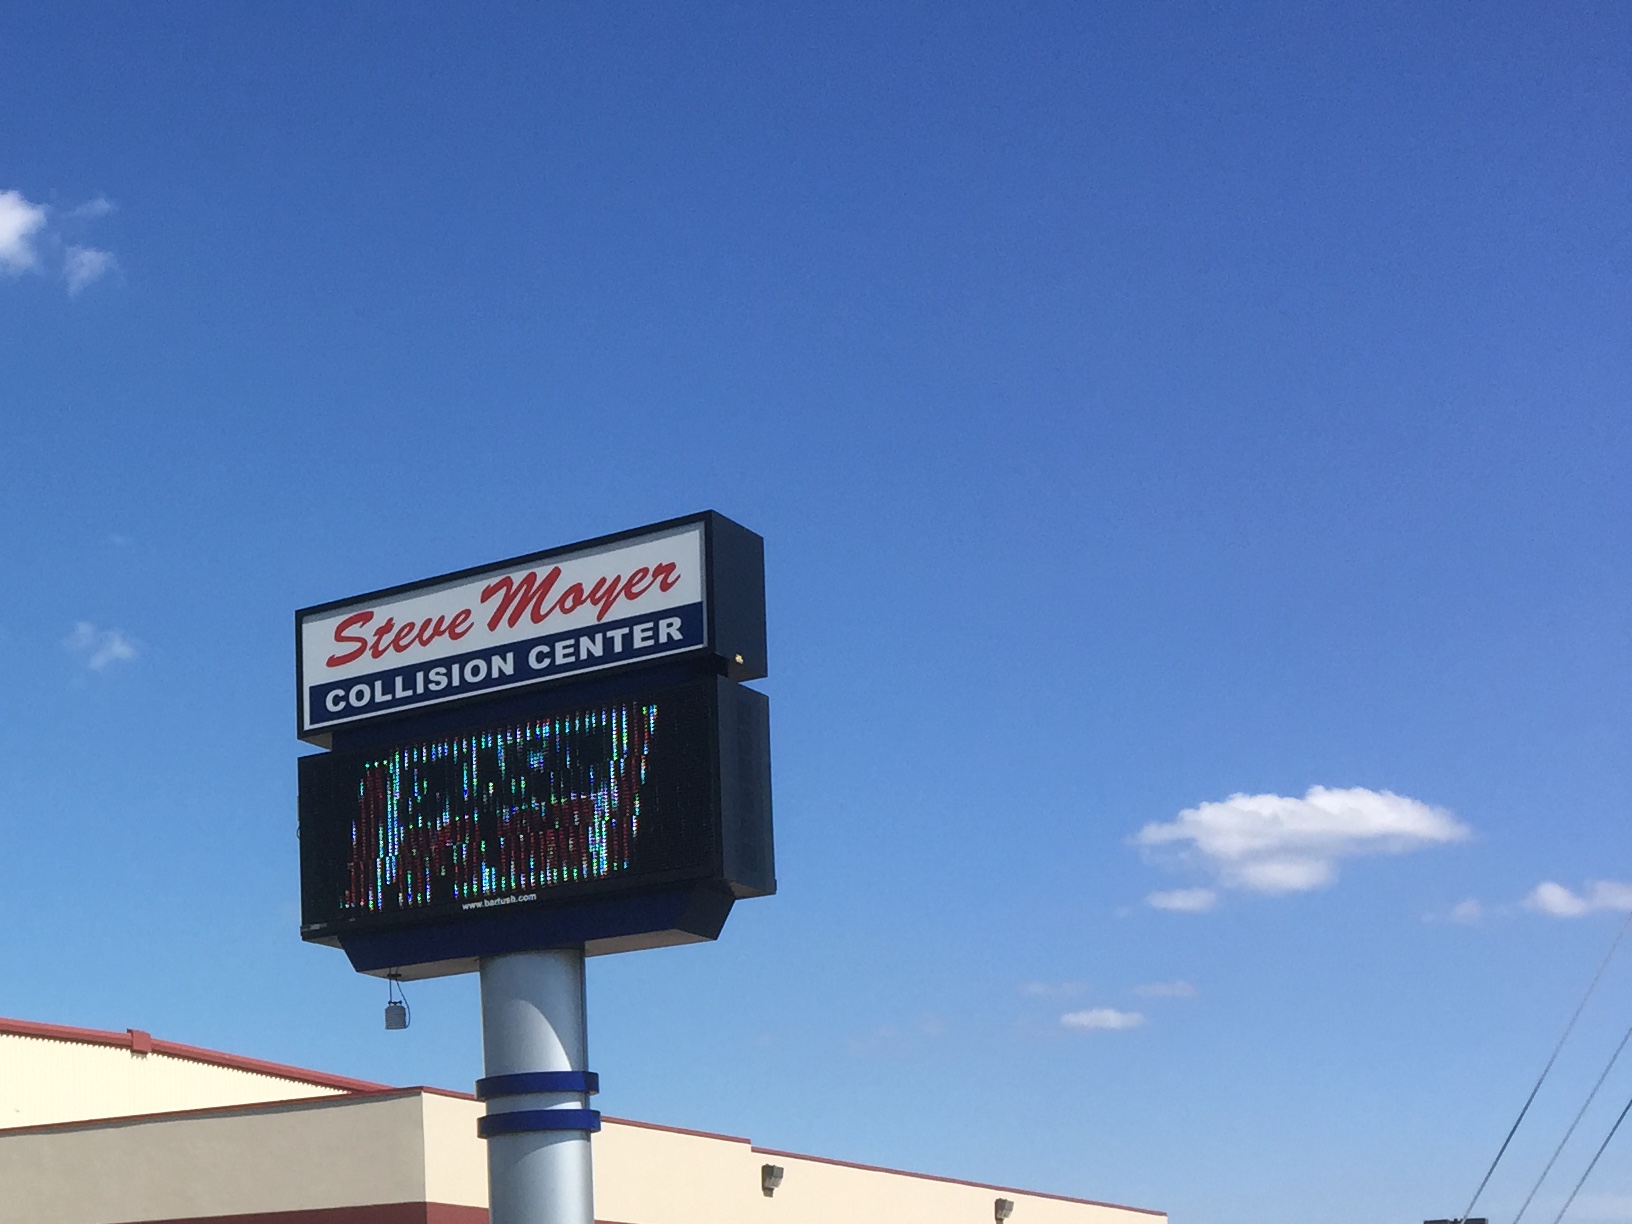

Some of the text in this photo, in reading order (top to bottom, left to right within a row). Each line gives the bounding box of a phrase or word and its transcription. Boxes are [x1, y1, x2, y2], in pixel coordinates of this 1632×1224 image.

[324, 616, 684, 713] COLLISION CENTER
[325, 562, 680, 668] Steve Moyer
